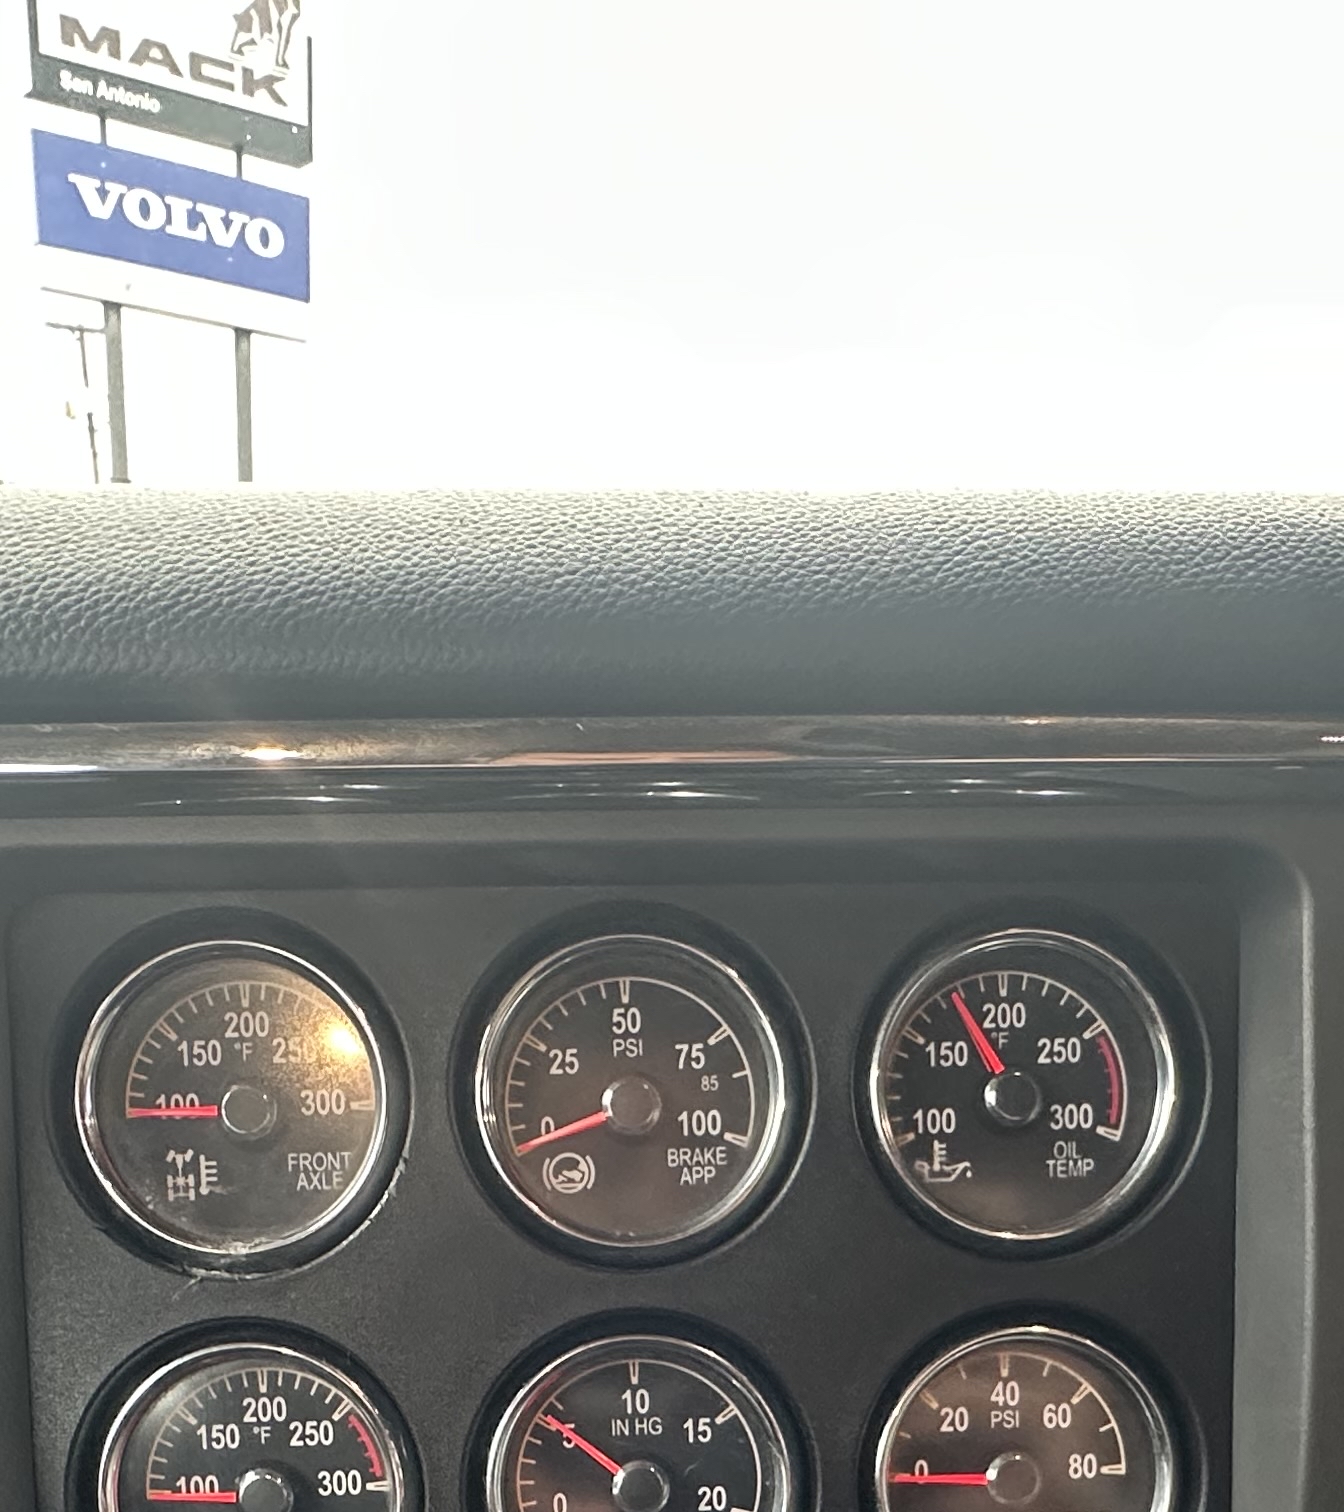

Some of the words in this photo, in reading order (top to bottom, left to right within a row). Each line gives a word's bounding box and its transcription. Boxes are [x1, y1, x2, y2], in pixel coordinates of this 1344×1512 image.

[59, 13, 288, 107] MACK
[59, 69, 94, 97] San
[96, 79, 162, 114] Antonio
[66, 171, 286, 259] VOLVO
[223, 1011, 270, 1039] 200
[611, 1007, 642, 1035] 50
[981, 1002, 1026, 1030] 200
[177, 1039, 222, 1067] 150
[548, 1048, 579, 1075] 25
[612, 1038, 644, 1058] PSI
[674, 1042, 706, 1070] 75
[925, 1041, 969, 1067] 150
[1037, 1037, 1082, 1065] 250
[700, 1074, 719, 1092] 85
[299, 1089, 346, 1116] 300
[677, 1109, 722, 1138] 100
[912, 1108, 956, 1135] 100
[1049, 1103, 1093, 1131] 300
[287, 1151, 351, 1172] FRONT
[667, 1146, 728, 1167] BRAKE
[1053, 1140, 1083, 1159] OIL
[296, 1171, 344, 1191] AXLE
[679, 1166, 716, 1186] APP
[1045, 1158, 1095, 1179] TEMP
[621, 1388, 651, 1415] 10
[990, 1380, 1020, 1407] 40
[242, 1396, 288, 1424] 200
[939, 1406, 969, 1433] 20
[990, 1409, 1020, 1429] PSI
[1042, 1402, 1072, 1430] 60
[196, 1423, 241, 1451] 150
[288, 1419, 334, 1447] 250
[611, 1418, 630, 1437] IN
[635, 1416, 663, 1436] HG
[682, 1417, 712, 1444] 15
[1068, 1452, 1098, 1480] 80
[317, 1469, 362, 1497] 300
[697, 1485, 727, 1512] 20
